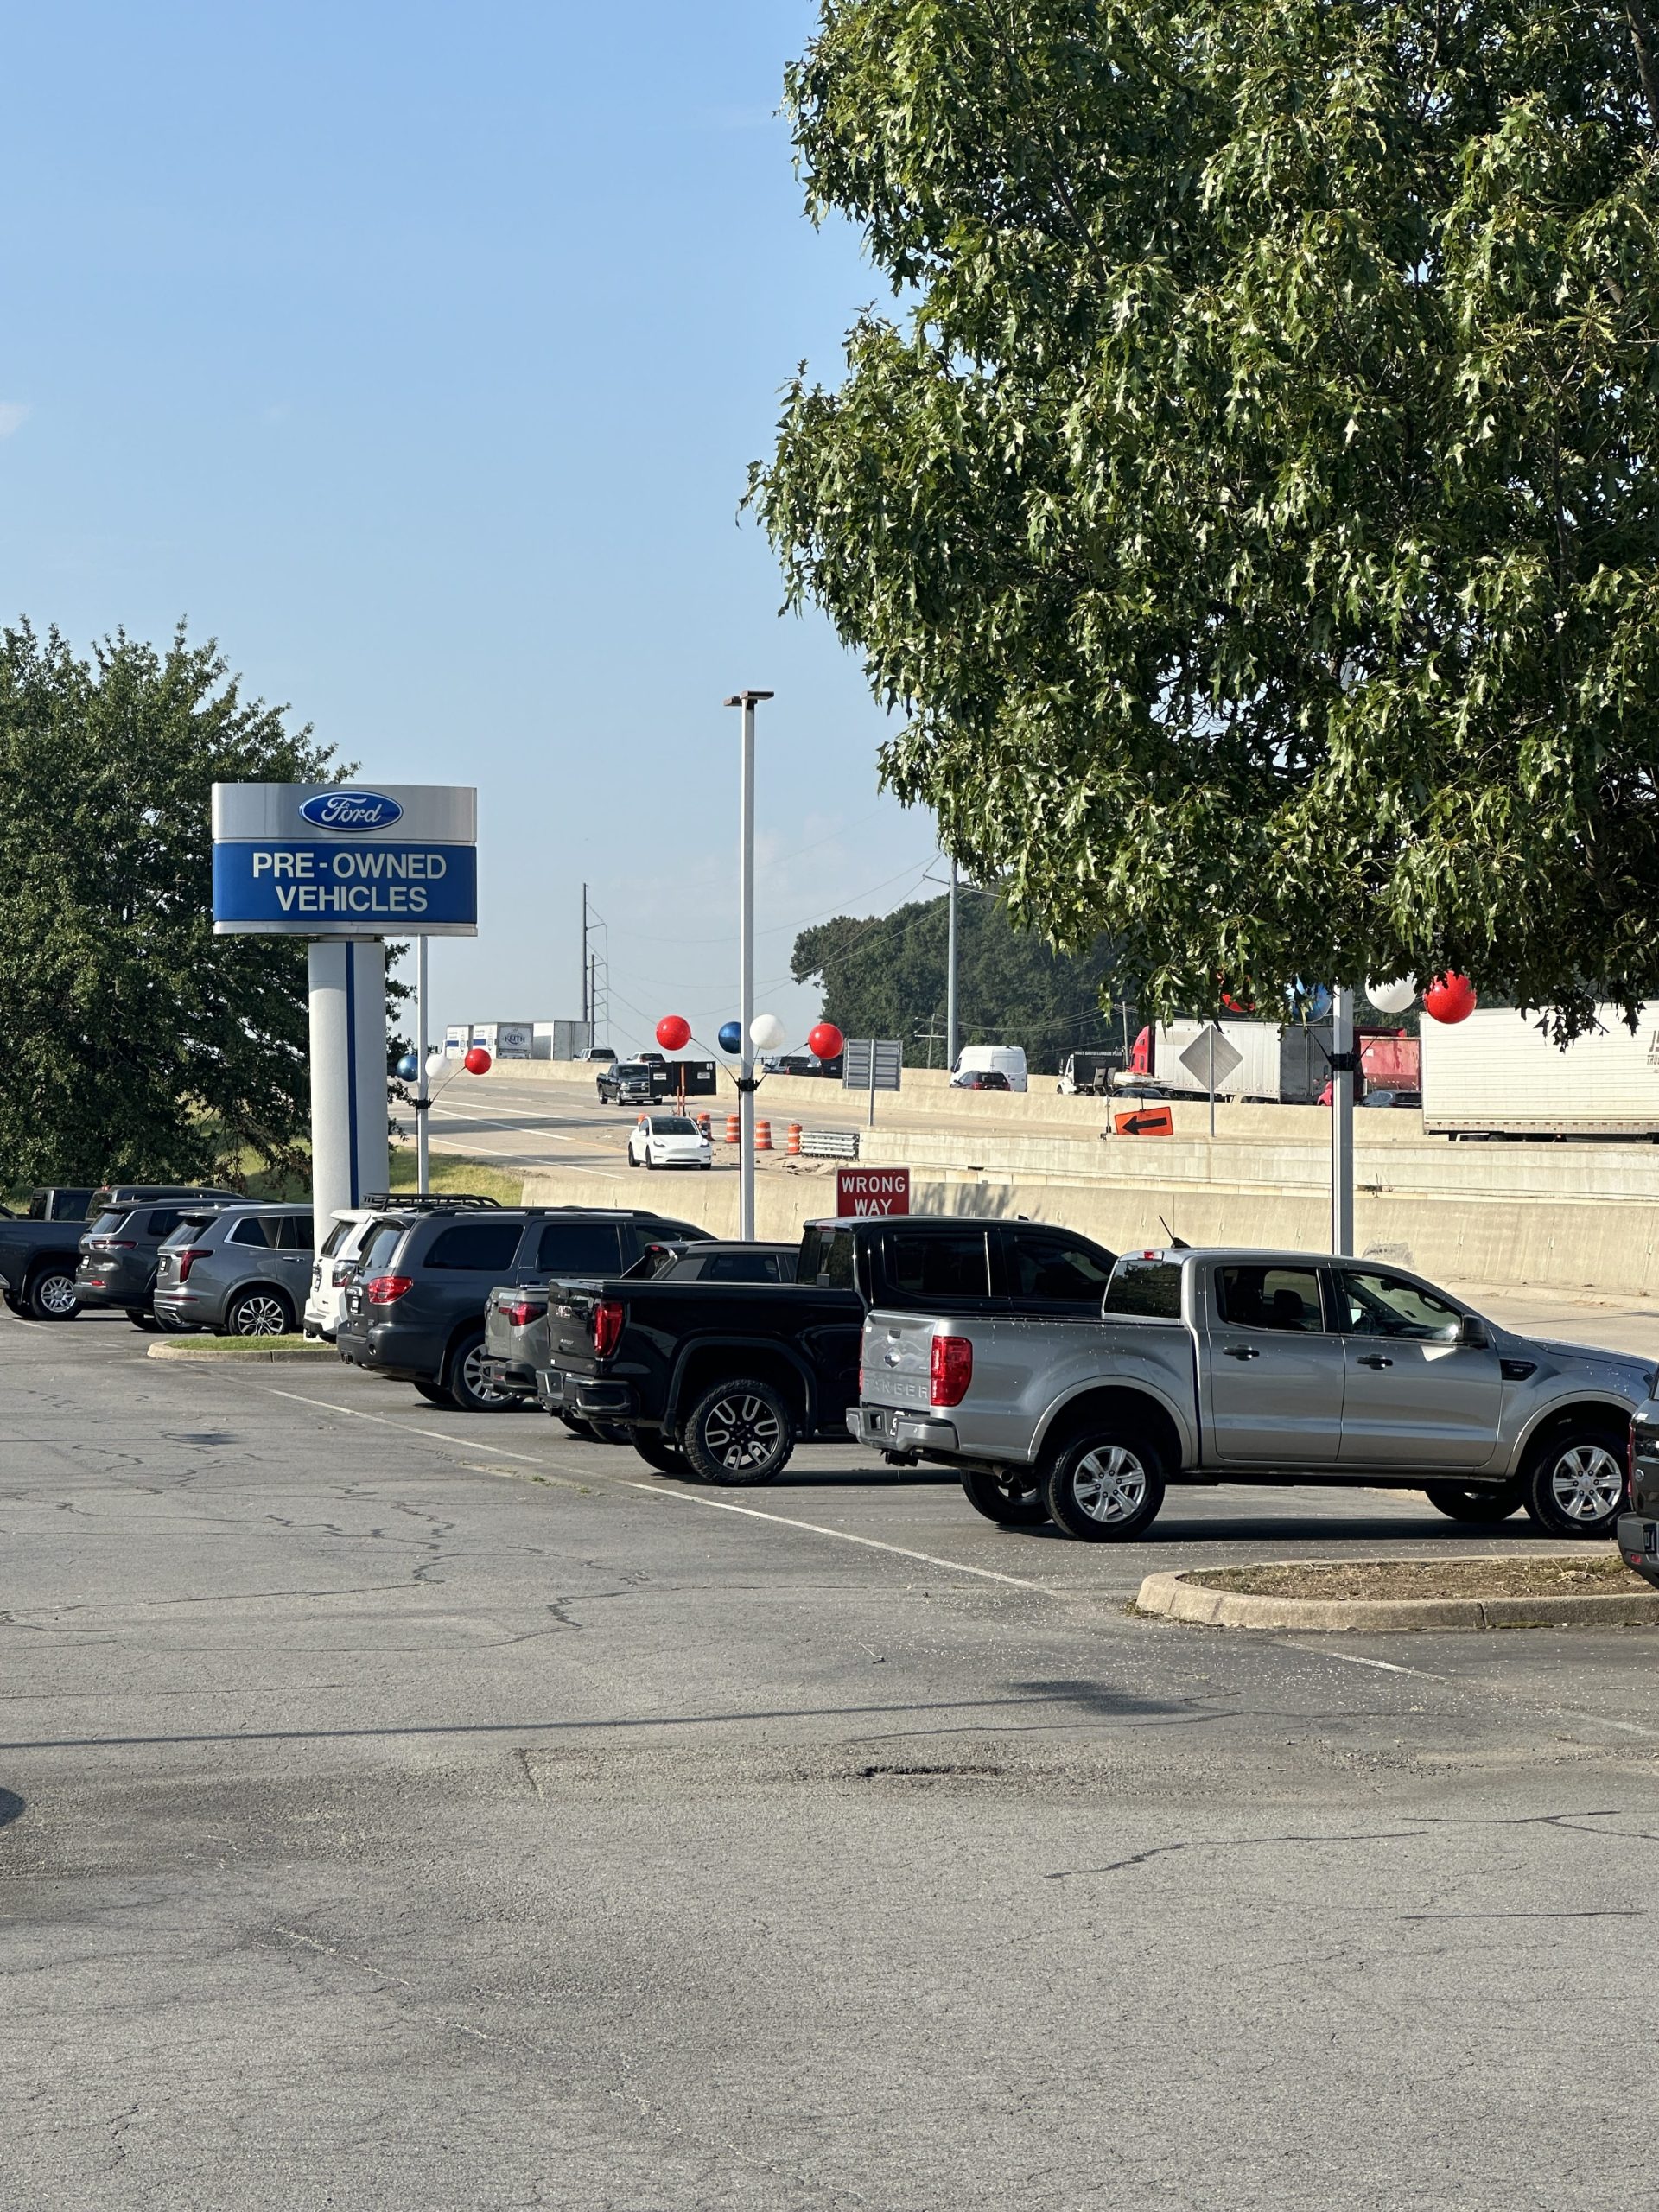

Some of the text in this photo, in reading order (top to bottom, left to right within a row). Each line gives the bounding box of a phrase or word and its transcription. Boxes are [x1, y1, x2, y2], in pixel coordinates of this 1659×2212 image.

[321, 796, 383, 823] Ford
[252, 852, 447, 880] PRE-OWNED
[275, 885, 428, 912] VEHICLES
[841, 1176, 906, 1193] WRONG
[855, 1198, 892, 1217] WAY
